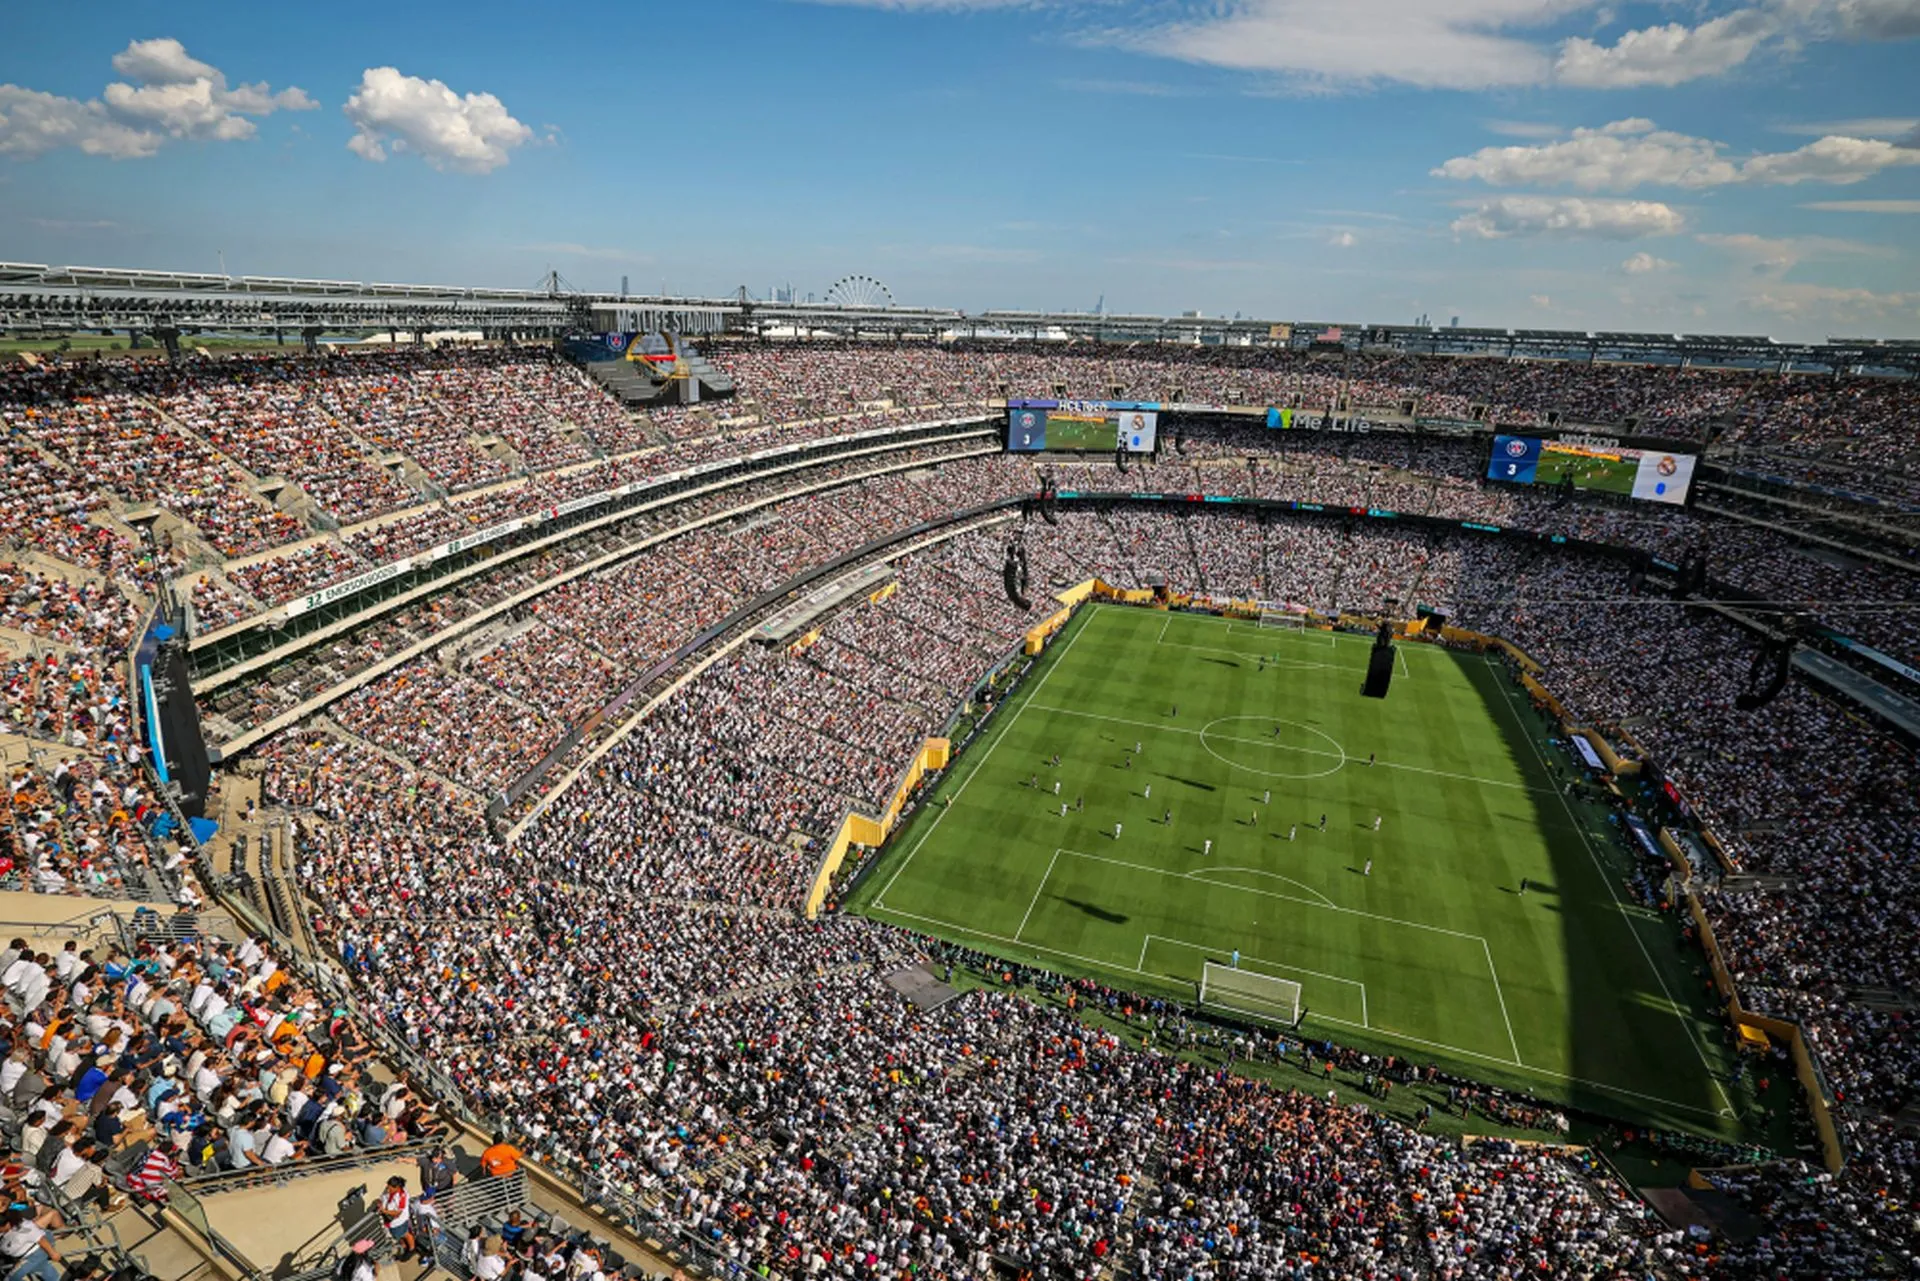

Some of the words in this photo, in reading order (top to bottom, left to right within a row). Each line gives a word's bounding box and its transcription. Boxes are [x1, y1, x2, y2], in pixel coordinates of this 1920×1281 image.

[616, 309, 670, 333] METLIFE
[673, 311, 724, 334] STADIUM
[1292, 413, 1371, 433] MeLife
[1023, 434, 1031, 445] 3
[1132, 435, 1140, 447] 0
[1559, 433, 1620, 448] verizon
[1507, 463, 1517, 475] 3
[1655, 482, 1666, 495] 0
[305, 593, 322, 610] 32
[326, 579, 366, 599] EMERSON
